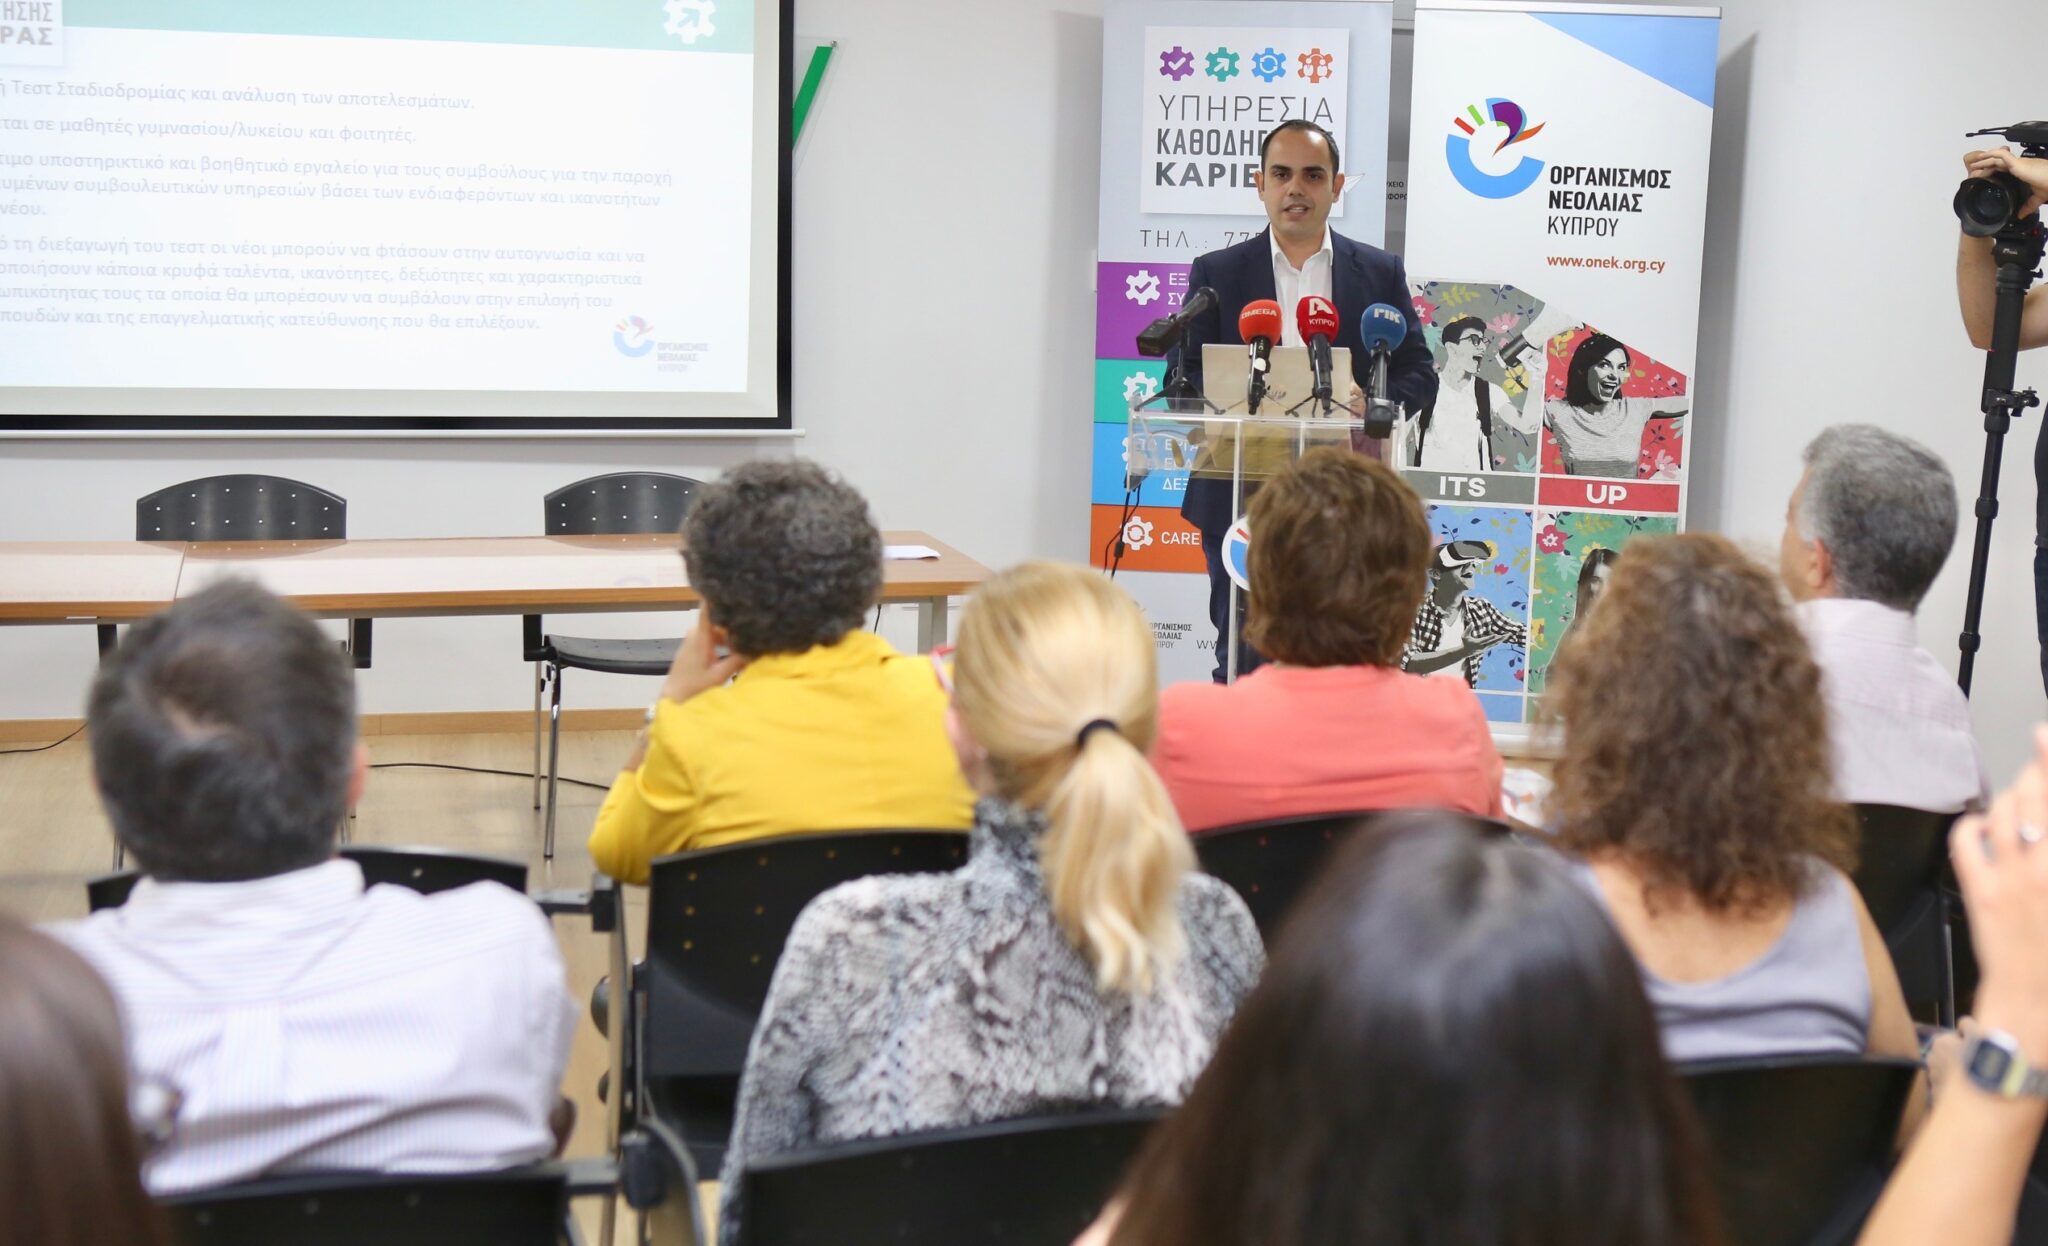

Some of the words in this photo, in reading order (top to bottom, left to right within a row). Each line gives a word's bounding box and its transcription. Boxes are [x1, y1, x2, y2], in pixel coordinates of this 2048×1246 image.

[10, 80, 52, 96] Τεστ
[56, 82, 187, 102] Σταδιοδρομίας
[191, 89, 217, 101] και
[222, 86, 296, 106] ανάλυση
[302, 91, 333, 105] των
[338, 91, 475, 110] αποτελεσμάτων.
[1159, 94, 1334, 123] ΥΠΗΡΕΣΙΑ
[33, 119, 55, 131] σε
[60, 117, 133, 136] μαθητές
[309, 126, 334, 139] και
[339, 124, 417, 145] φοιτητές.
[1157, 128, 1268, 156] ΚΑΘΟΔΗΓ
[39, 154, 164, 171] υποστηρικτικό
[169, 157, 197, 170] και
[200, 155, 289, 175] βοηθητικό
[294, 158, 369, 178] εργαλείο
[373, 163, 400, 178] για
[404, 164, 441, 180] τους
[445, 162, 547, 181] συμβούλους
[551, 168, 577, 183] για
[582, 170, 608, 184] την
[612, 168, 673, 188] παροχή
[1155, 162, 1259, 188] ΚΑΡΙΕ
[1550, 166, 1672, 189] ΟΡΓΑΝΙΣΜΟΣ
[74, 176, 218, 195] συμβουλευτικών
[223, 181, 316, 200] υπηρεσιών
[321, 182, 368, 200] βάσει
[373, 186, 403, 199] των
[408, 185, 535, 204] ενδιαφερόντων
[541, 190, 564, 204] και
[1548, 190, 1643, 213] ΝΕΟΛΑΙΑΣ
[1547, 215, 1619, 237] ΚΥΠΡΟΥ
[13, 239, 32, 253] τη
[38, 235, 129, 255] διεξαγωγή
[133, 239, 164, 253] του
[169, 241, 205, 254] τεστ
[211, 242, 227, 254] οι
[232, 240, 266, 255] νέοι
[272, 241, 346, 258] μπορούν
[350, 244, 370, 257] να
[376, 242, 449, 260] φτάσουν
[452, 248, 490, 261] στην
[495, 246, 592, 264] αυτογνωσία
[597, 250, 622, 263] και
[624, 251, 646, 263] να
[96, 260, 157, 277] κάποια
[162, 262, 219, 280] κρυφά
[398, 265, 485, 285] δεξιότητες
[488, 270, 513, 284] και
[1546, 256, 1666, 274] www.onek.org.cy
[103, 287, 142, 303] τους
[146, 288, 166, 301] τα
[171, 286, 221, 302] οποία
[226, 287, 249, 302] θα
[254, 288, 348, 305] μπορέσουν
[352, 292, 372, 304] να
[378, 289, 471, 307] συμβάλουν
[475, 293, 512, 307] στην
[517, 292, 580, 309] επιλογή
[585, 294, 613, 307] του
[75, 311, 102, 324] και
[106, 311, 134, 326] της
[139, 309, 275, 328] επαγγελματικής
[279, 311, 388, 329] κατεύθυνσης
[392, 315, 424, 328] που
[429, 313, 450, 328] θα
[455, 314, 541, 332] επιλέξουν.
[1241, 308, 1278, 320] OMEGA
[1309, 318, 1336, 328] ΚΥΠΡΟΥ
[1439, 475, 1486, 498] ITS
[1585, 483, 1628, 505] UP
[1152, 631, 1183, 640] ΕΟΛΑΙΑΣ
